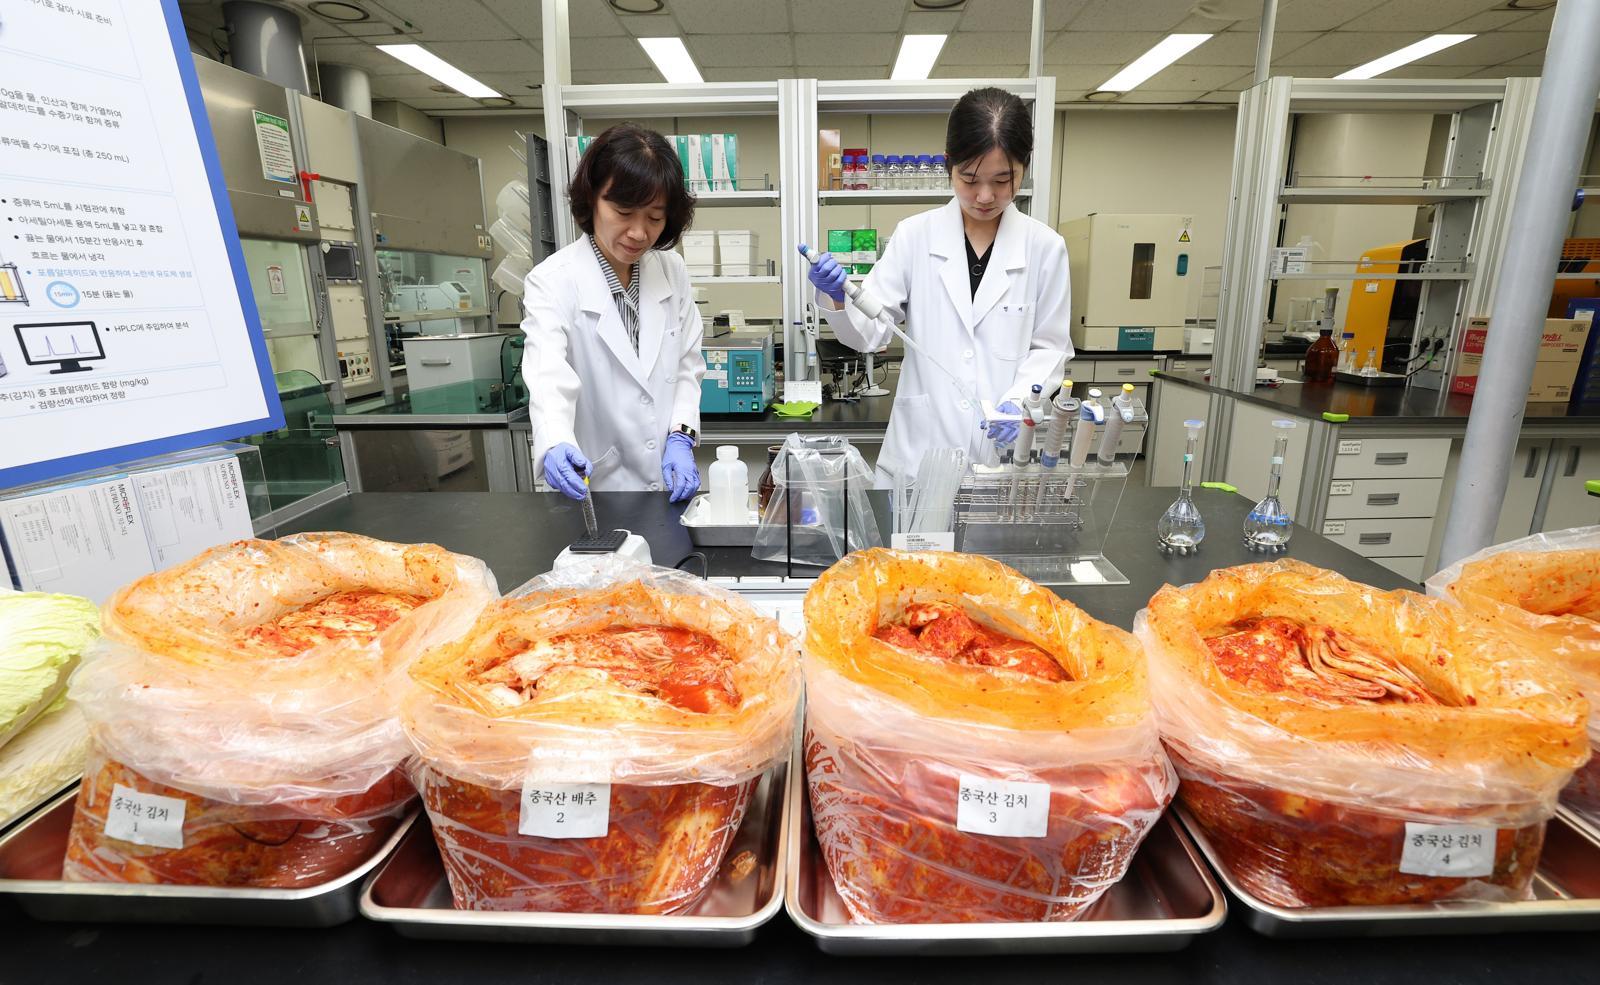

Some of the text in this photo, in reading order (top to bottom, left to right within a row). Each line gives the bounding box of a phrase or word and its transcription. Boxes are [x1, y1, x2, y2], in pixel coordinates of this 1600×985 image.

[55, 2, 74, 15] 갈아
[76, 9, 94, 20] 시료
[95, 14, 113, 26] 준비
[26, 92, 39, 104] 물,
[41, 95, 68, 108] 인산과
[70, 101, 88, 112] 함께
[90, 105, 122, 119] 가열하여
[48, 110, 83, 122] 수증기와
[85, 115, 103, 126] 함께
[104, 119, 120, 129] 증류
[33, 142, 61, 154] 수기에
[63, 146, 80, 157] 포집
[82, 149, 94, 159] (총
[95, 151, 113, 161] 250
[114, 155, 130, 163] mL)
[13, 197, 126, 215] 증류액 5mL를 시험관에 취함
[18, 216, 163, 233] 아세틸아세톤 용액 5mL를 넣고 잘 혼합
[25, 233, 144, 247] 끓는 물에서 15분간 반응시킨 후
[31, 252, 105, 262] 흐르는 물에서 냉각
[38, 268, 98, 278] 포름알데히드와
[99, 269, 131, 279] 반응하여
[133, 270, 155, 278] 노란색
[156, 270, 178, 278] 유도체
[81, 289, 134, 299] 15분 (끓는 물)
[113, 320, 190, 333] HPLC에 주입하여 분석
[38, 388, 47, 397] 중
[49, 382, 100, 396] 포름알데히드
[101, 380, 118, 390] 함량
[119, 377, 149, 388] (mg/kg)
[38, 397, 74, 410] 검량선에
[75, 393, 108, 404] 대입하여
[110, 390, 126, 400] 정량
[118, 483, 135, 525] MICROFLEX
[529, 789, 597, 806] 중국산 배추
[960, 787, 1028, 808] 중국산 김치
[114, 797, 169, 821] 중국산 김치
[556, 811, 565, 823] 2
[989, 811, 997, 823] 3
[133, 822, 138, 832] 1
[1411, 833, 1482, 848] 중국산 김치
[1441, 853, 1450, 864] 4
